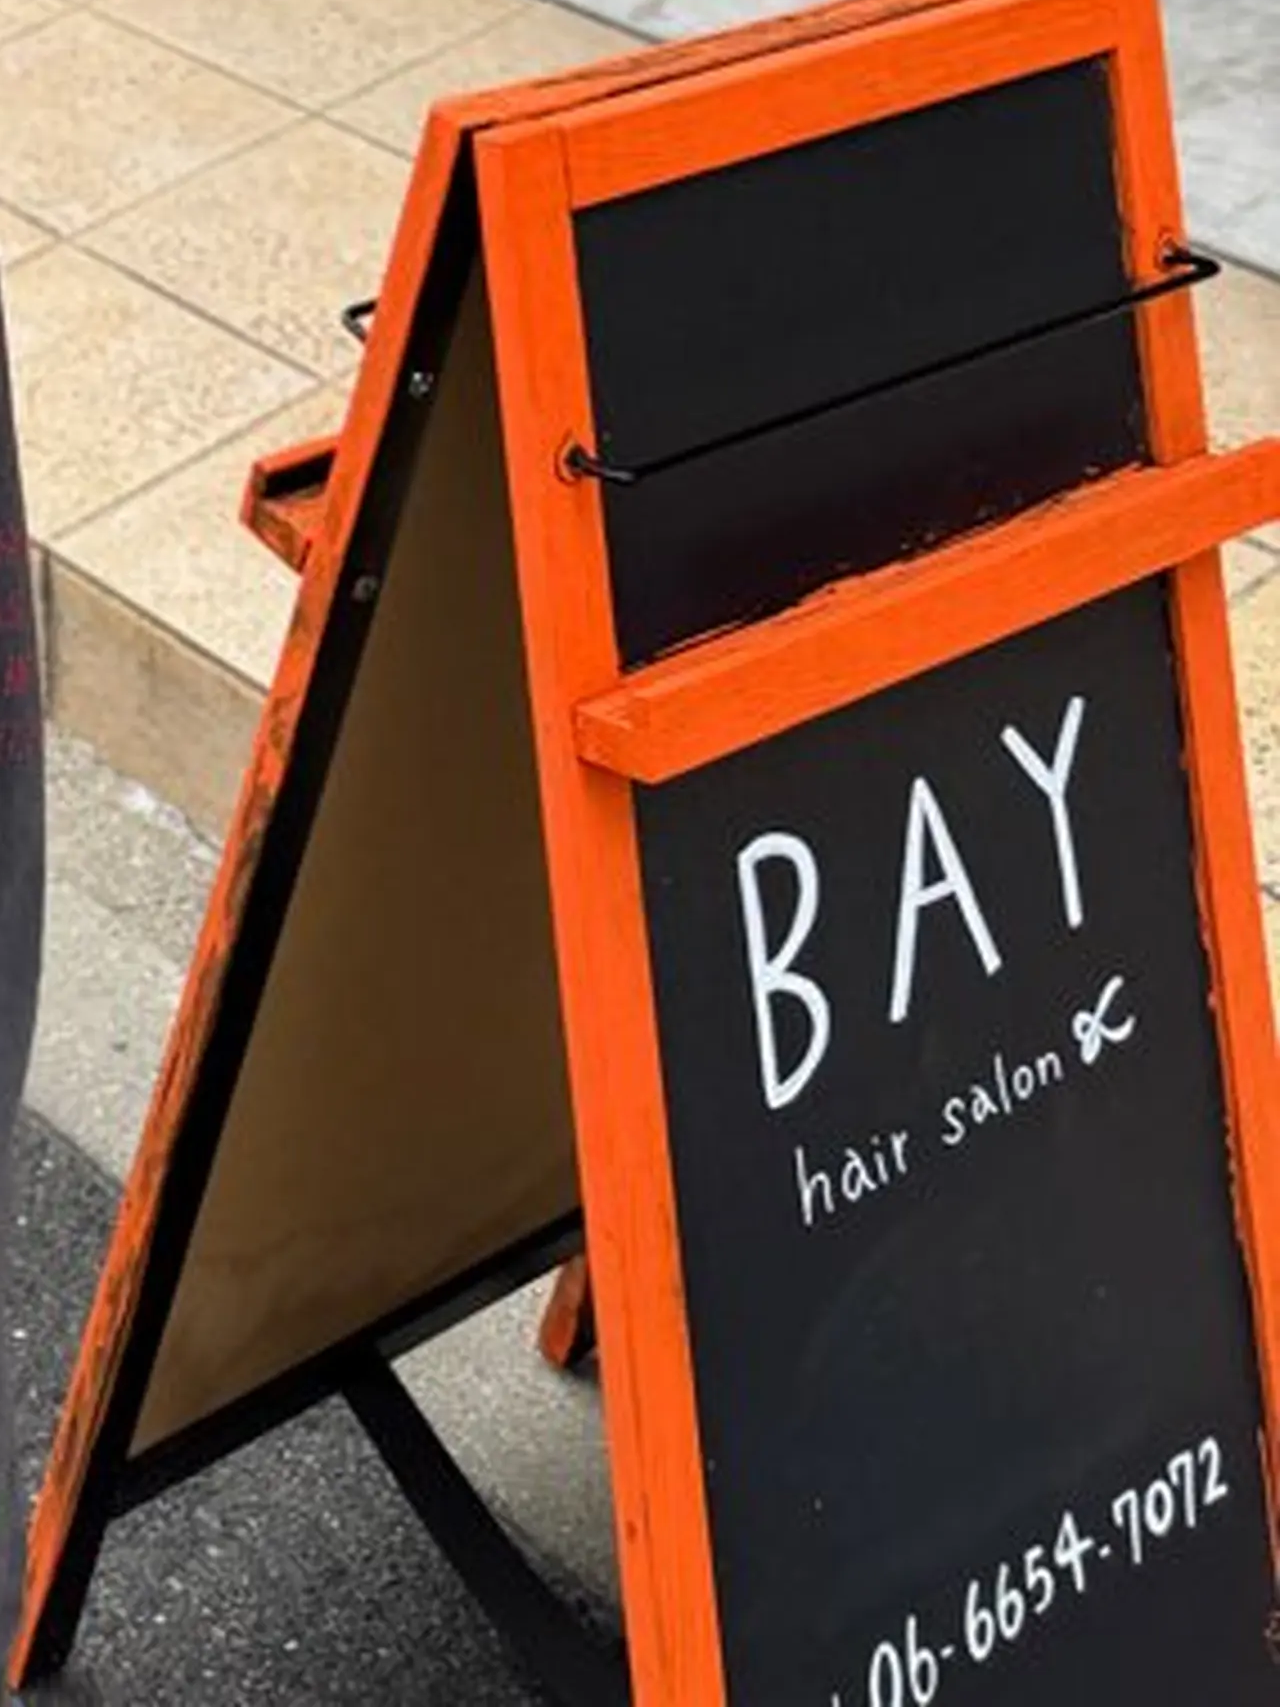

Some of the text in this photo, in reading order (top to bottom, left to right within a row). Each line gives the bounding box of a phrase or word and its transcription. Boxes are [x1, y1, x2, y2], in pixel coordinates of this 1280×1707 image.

[737, 696, 1085, 1110] BAY
[794, 1052, 1064, 1227] hair salon
[868, 1435, 1228, 1707] 06-6654-7072
